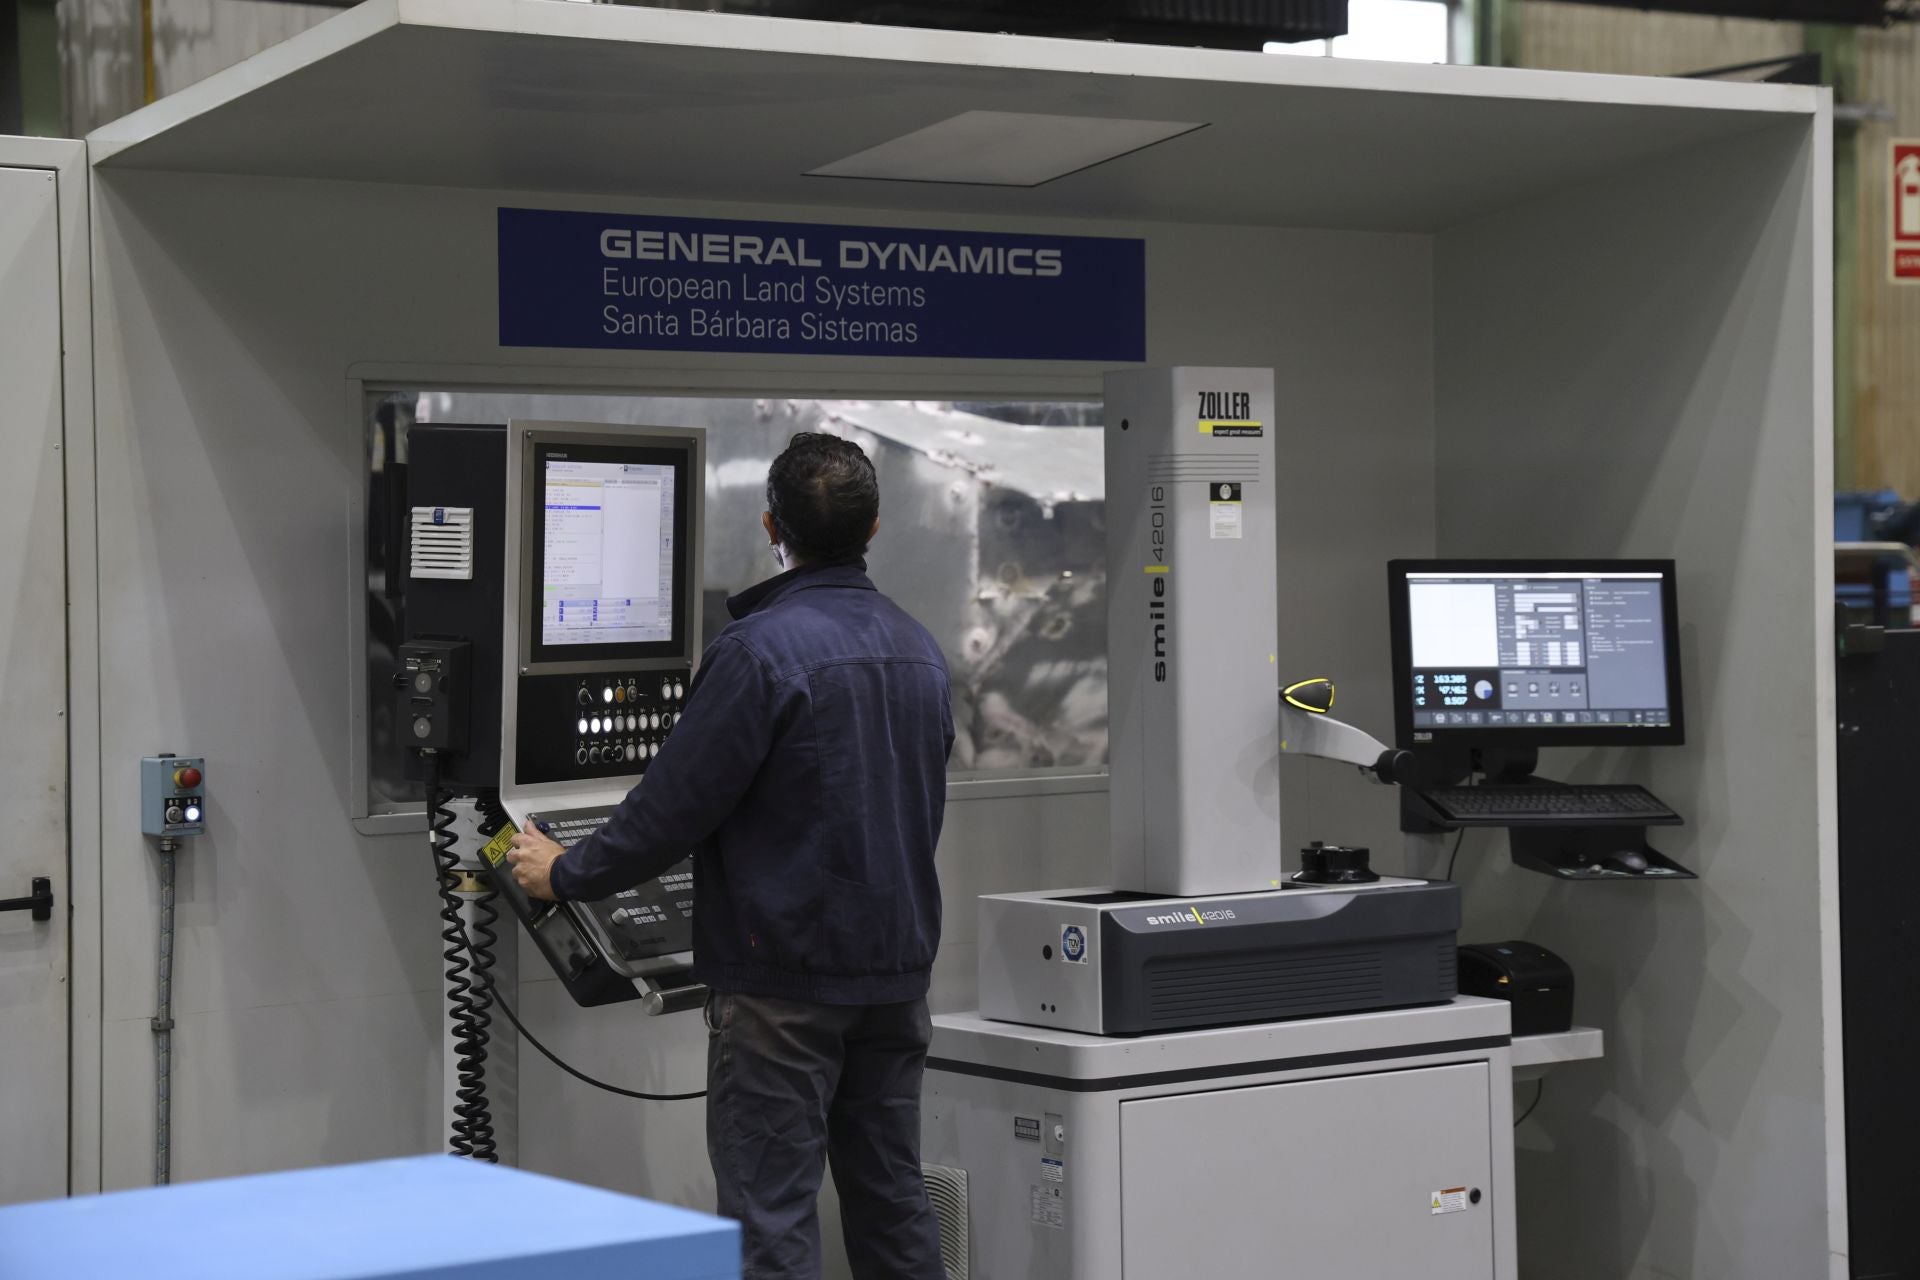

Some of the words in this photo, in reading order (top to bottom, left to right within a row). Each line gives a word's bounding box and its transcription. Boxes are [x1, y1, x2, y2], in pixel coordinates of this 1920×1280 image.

[600, 228, 822, 267] GENERAL
[839, 240, 1063, 277] DYNAMICS
[603, 267, 731, 304] European
[743, 273, 805, 303] Land
[815, 275, 926, 311] Systems
[603, 305, 679, 335] Santa
[690, 308, 790, 339] Bárbara
[801, 312, 918, 343] Sistemas
[1198, 391, 1251, 420] ZOLLER
[1150, 576, 1166, 683] smile
[1146, 911, 1197, 925] smile
